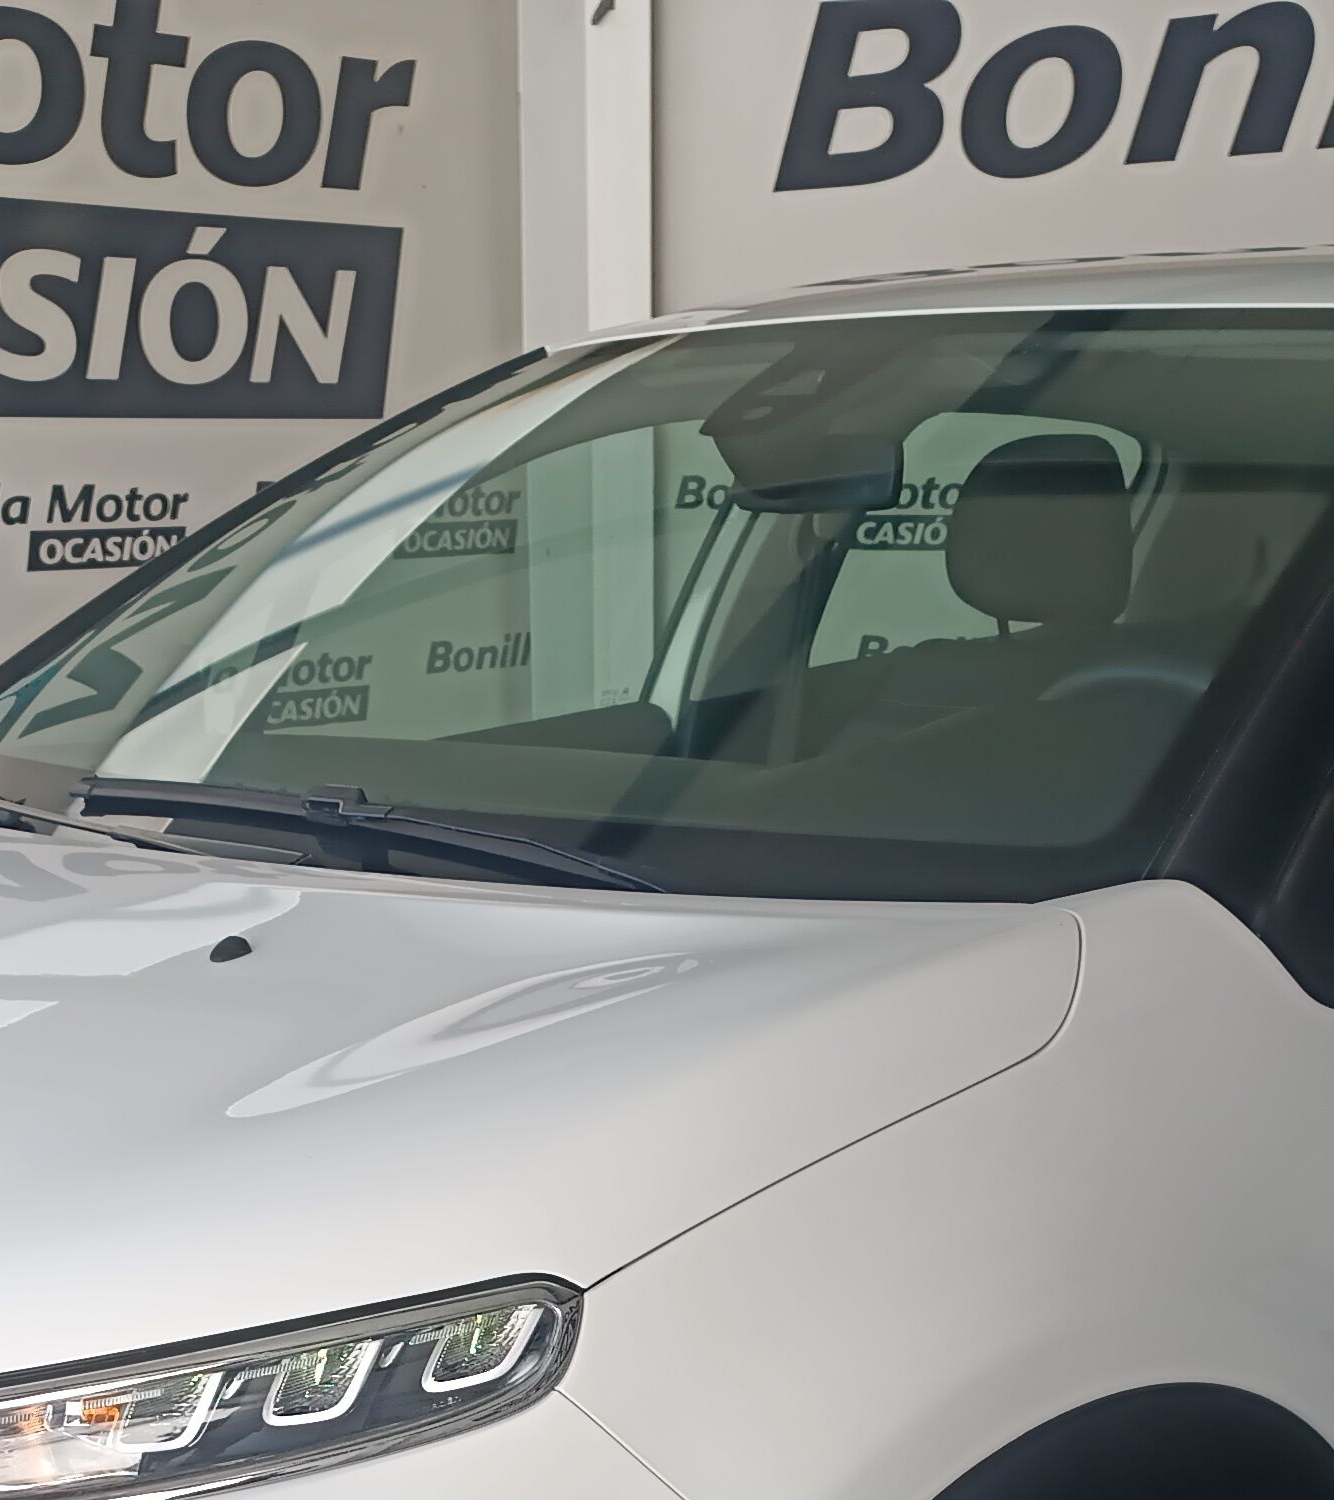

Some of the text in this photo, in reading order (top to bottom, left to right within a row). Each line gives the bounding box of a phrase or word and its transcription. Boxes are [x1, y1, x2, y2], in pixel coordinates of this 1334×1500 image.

[46, 483, 189, 523] Motor
[430, 487, 522, 518] otor
[404, 523, 512, 552] OCASIÓN
[278, 652, 373, 686] otor
